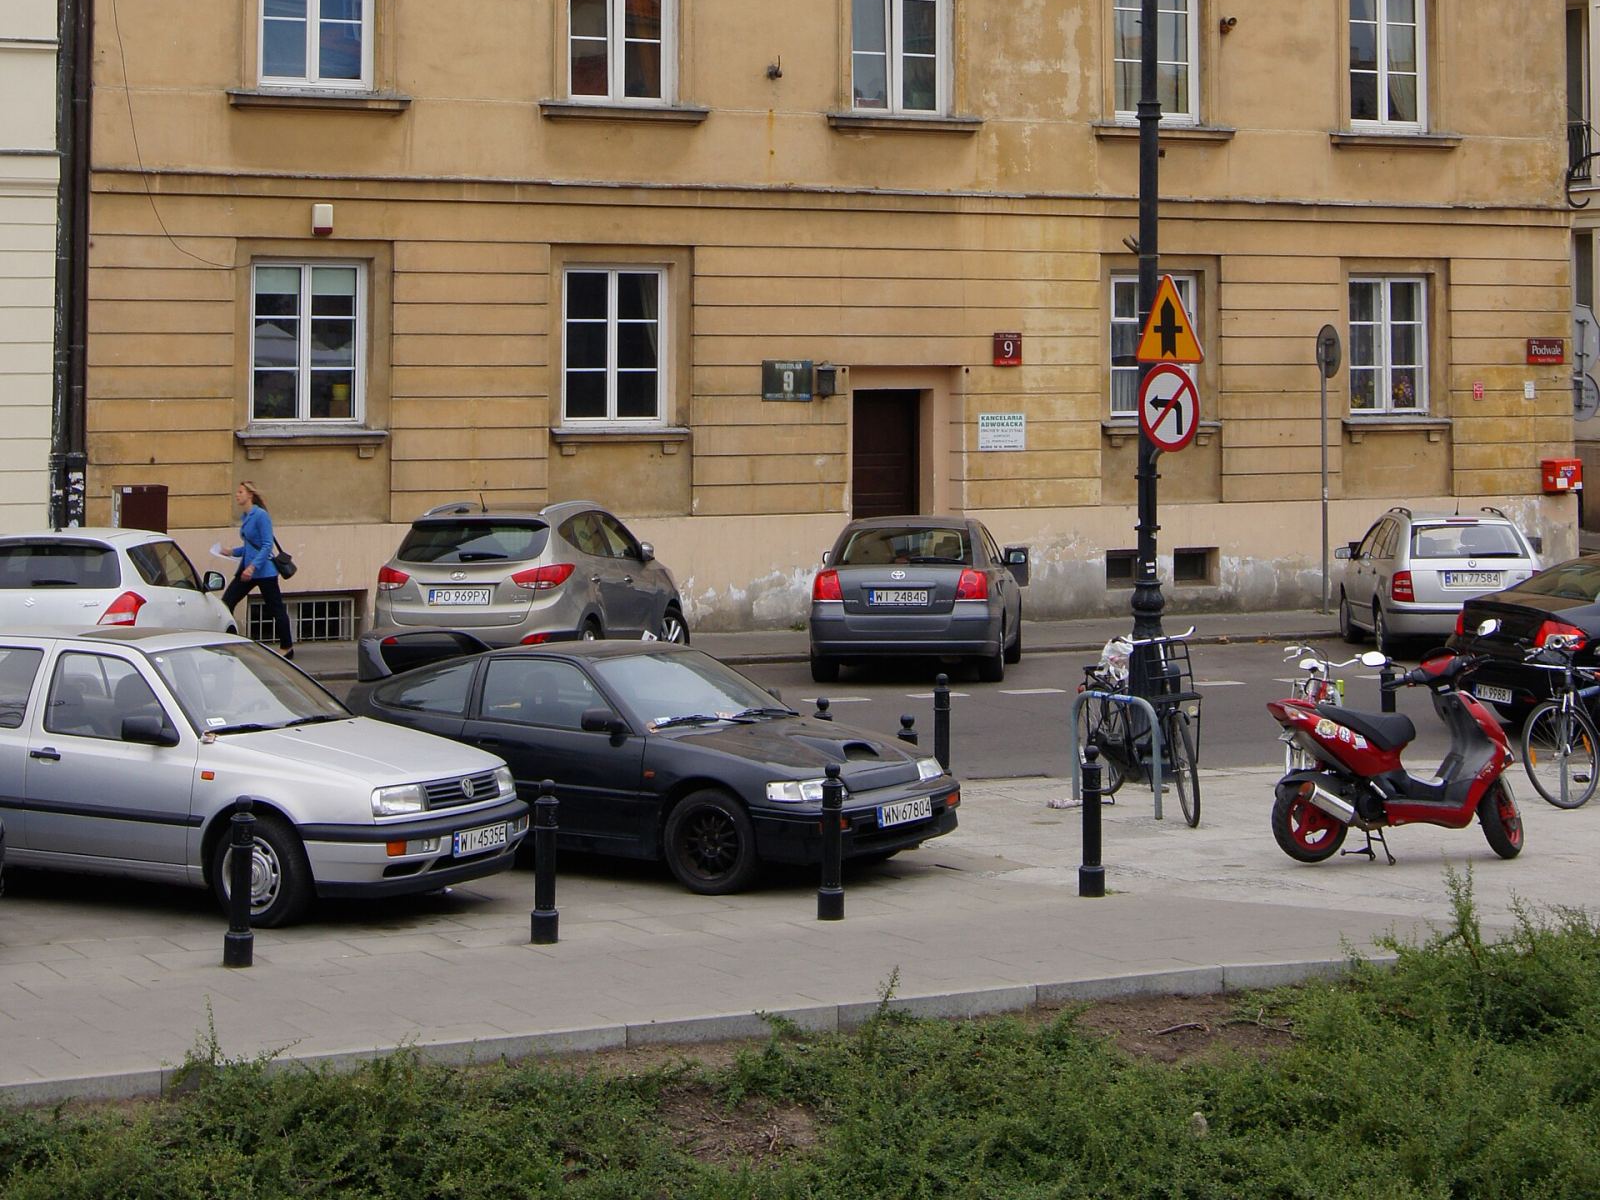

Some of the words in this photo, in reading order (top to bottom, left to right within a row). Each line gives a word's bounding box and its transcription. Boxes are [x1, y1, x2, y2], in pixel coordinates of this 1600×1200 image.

[1004, 340, 1013, 358] 9
[1531, 344, 1561, 355] Podwale
[783, 371, 793, 391] 9
[1452, 573, 1464, 583] WI
[1469, 573, 1499, 583] 77584
[435, 590, 451, 601] PO
[455, 590, 488, 601] 969PX
[875, 591, 889, 602] WI
[894, 591, 927, 602] 2484G
[884, 806, 899, 824] WN
[902, 800, 931, 820] 67804
[461, 832, 473, 851] WI
[478, 825, 505, 847] 4535E
